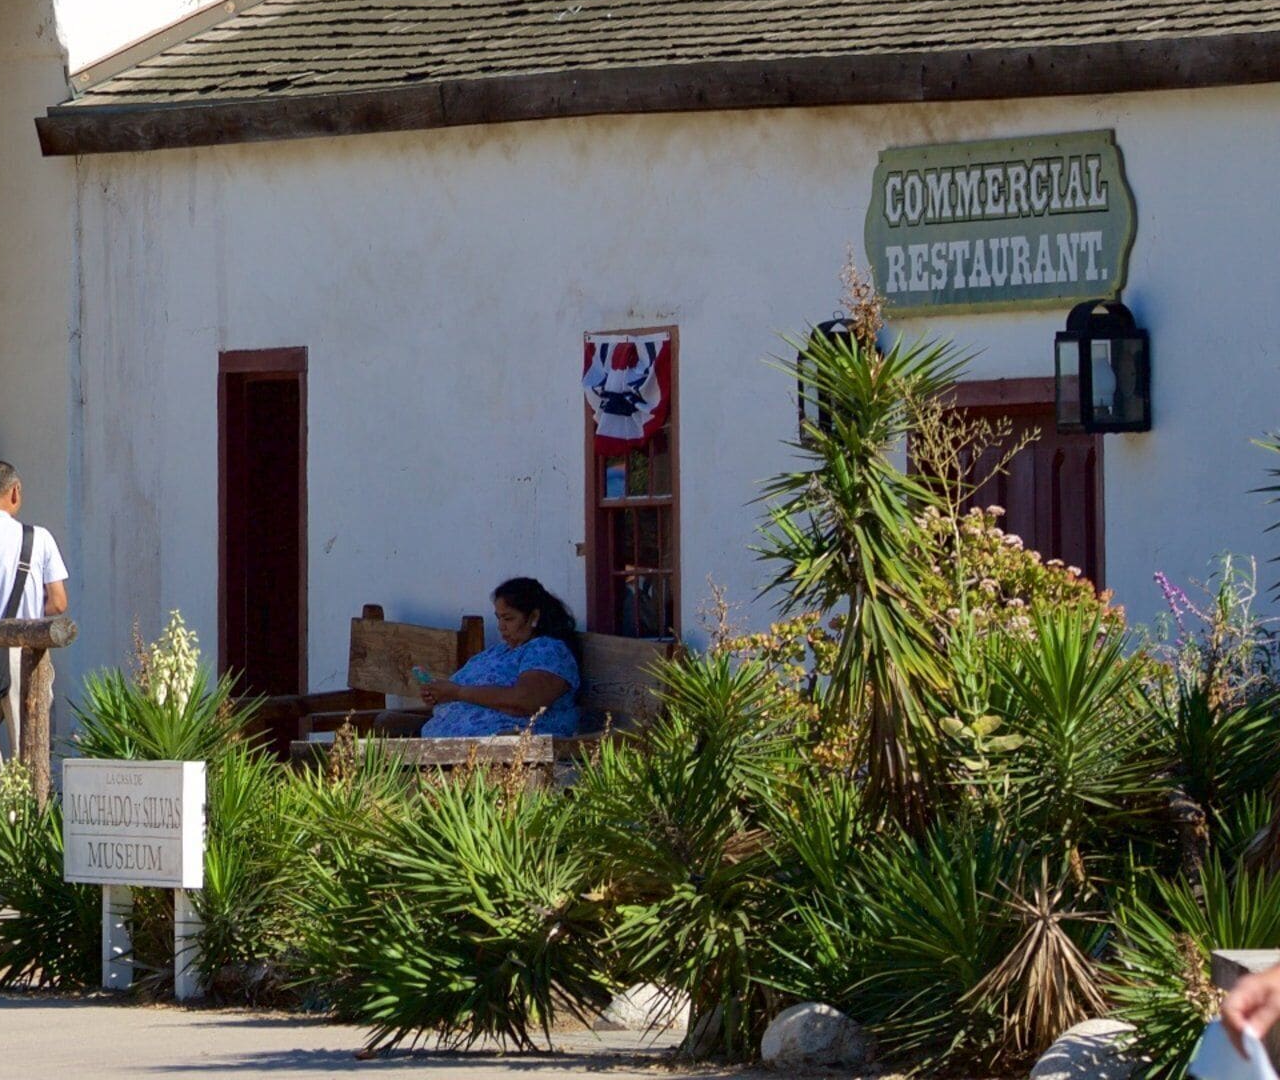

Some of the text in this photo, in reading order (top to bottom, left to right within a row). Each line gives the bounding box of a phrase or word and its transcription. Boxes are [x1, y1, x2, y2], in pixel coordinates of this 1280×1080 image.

[884, 156, 1108, 225] COMMERCIAL
[885, 230, 1108, 293] RESTAURANT.
[106, 773, 143, 786] LA CASA DE
[70, 793, 132, 828] MACHADO
[143, 796, 181, 829] SILVAS
[87, 841, 163, 871] MUSEUM
